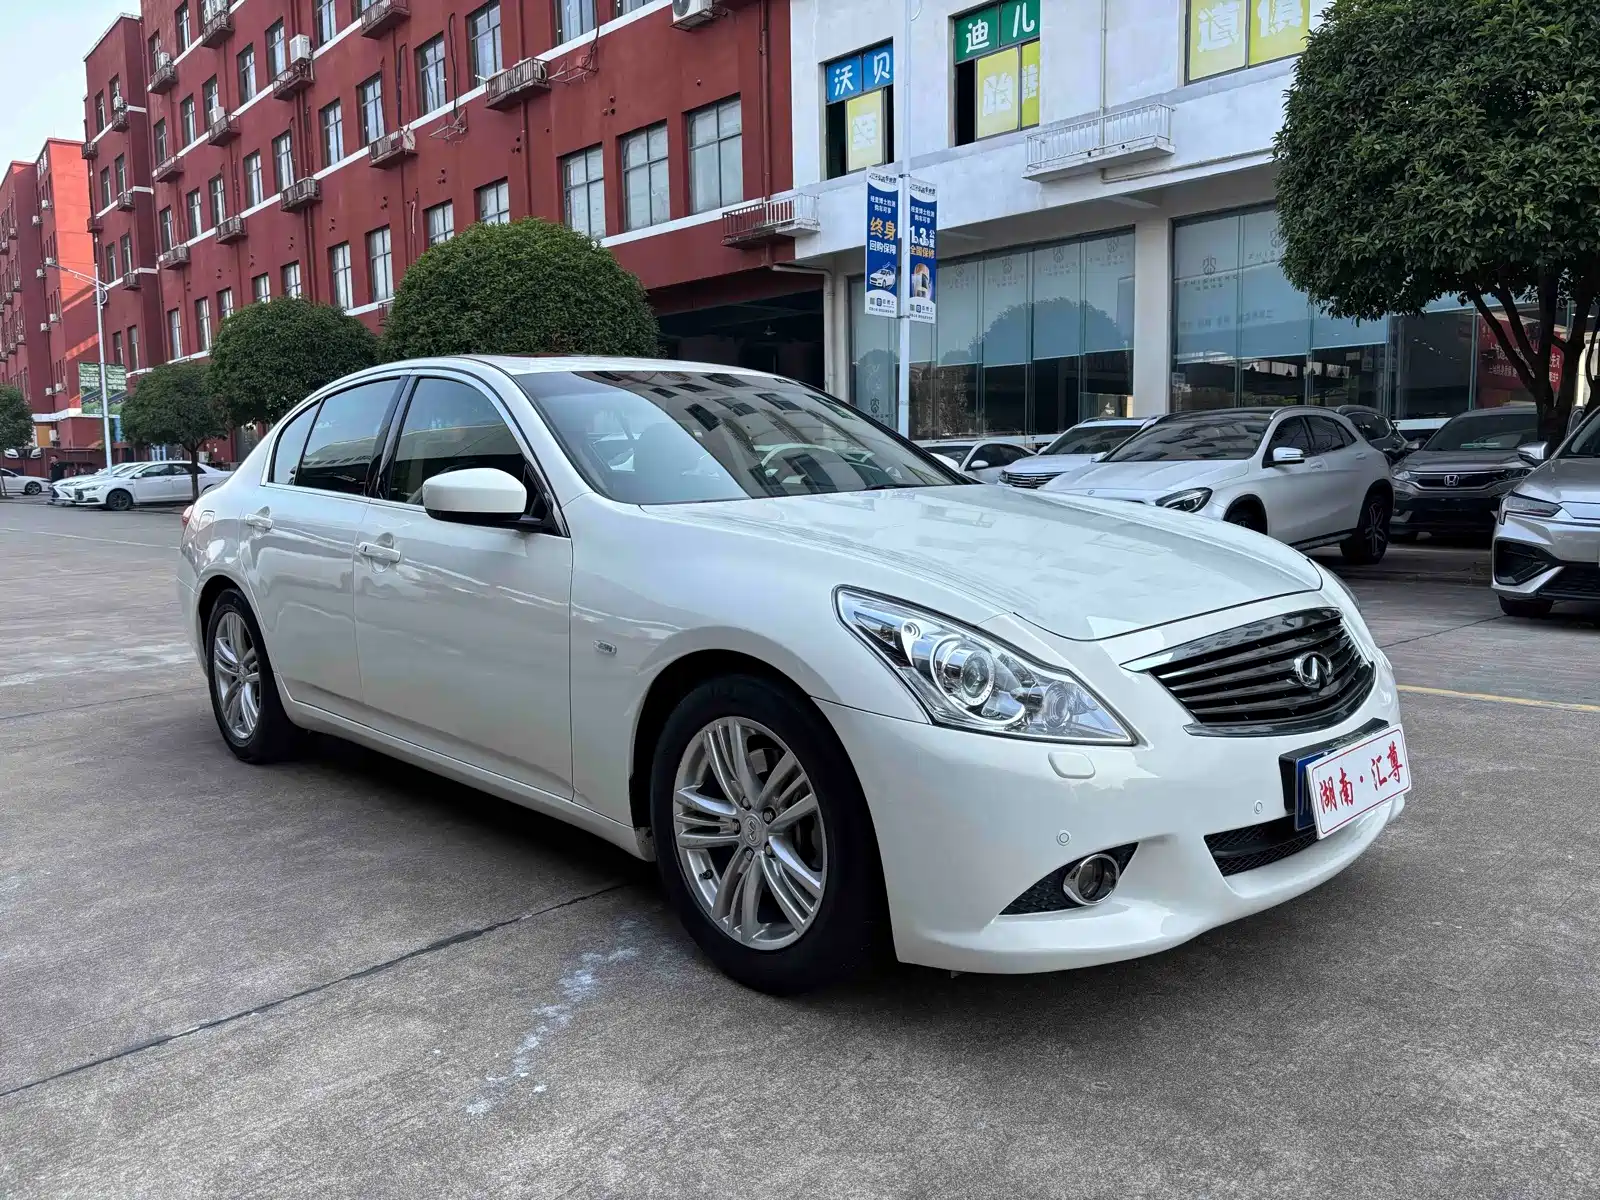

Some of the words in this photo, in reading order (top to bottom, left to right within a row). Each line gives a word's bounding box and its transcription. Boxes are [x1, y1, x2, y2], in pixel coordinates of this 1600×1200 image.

[965, 2, 1036, 53] 迪儿
[834, 51, 890, 96] 沃贝
[870, 216, 897, 241] 终身
[869, 240, 897, 255] 回购保障
[910, 245, 935, 259] 全国保修
